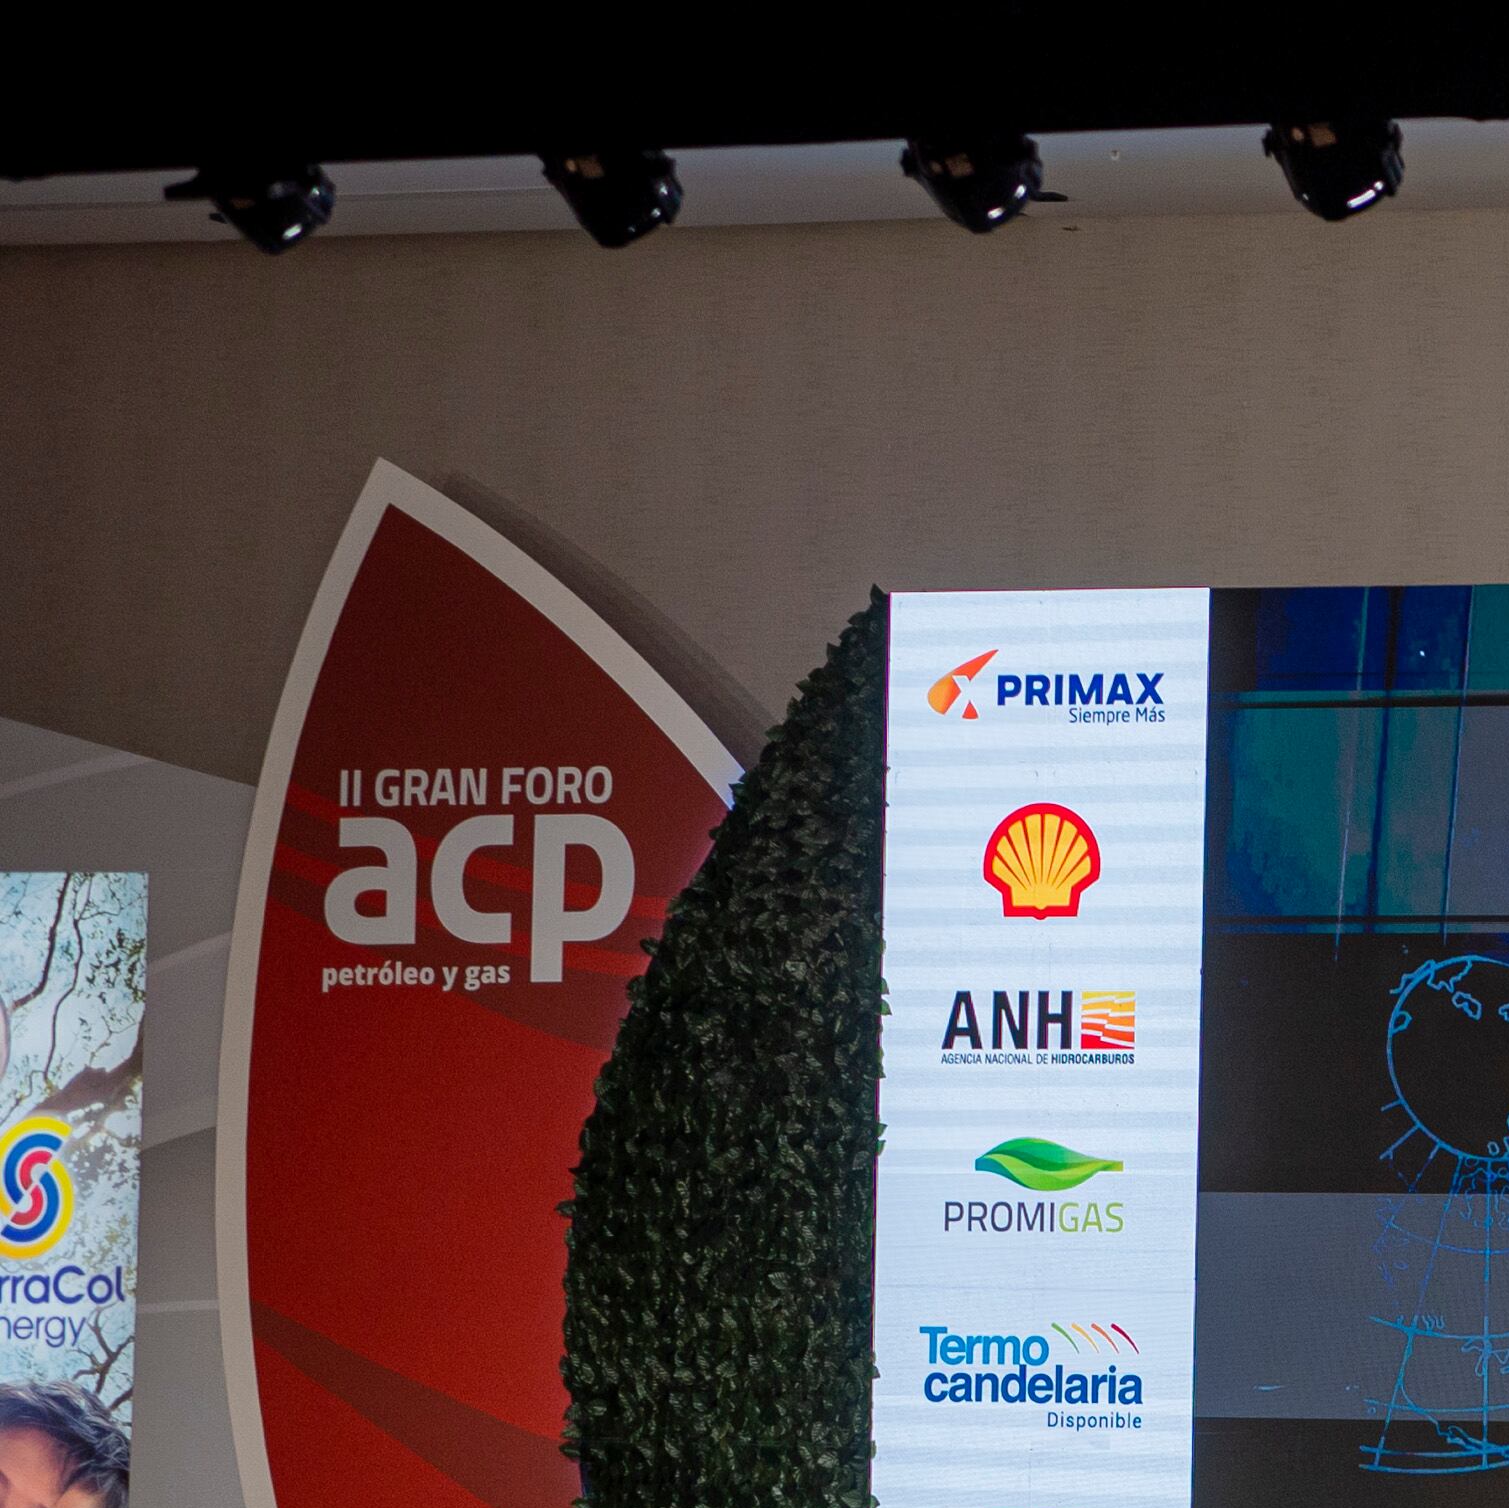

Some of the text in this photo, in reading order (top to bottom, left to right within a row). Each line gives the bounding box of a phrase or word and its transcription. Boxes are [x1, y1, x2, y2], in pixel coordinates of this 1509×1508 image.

[997, 672, 1165, 706] PRIMAX
[1069, 706, 1166, 726] Siempre Más
[339, 765, 613, 807] II GRAN FORO
[323, 813, 636, 983] acp
[321, 959, 511, 993] petróleo y gas
[940, 990, 1074, 1050] ANH
[941, 1053, 1135, 1065] AGENCIA NACIONAL DE HIDROCARBUROS
[944, 1200, 1125, 1233] PROMIGAS
[919, 1326, 1050, 1367] Termo
[923, 1365, 1144, 1405] candelaria
[1046, 1411, 1143, 1432] Disponible
